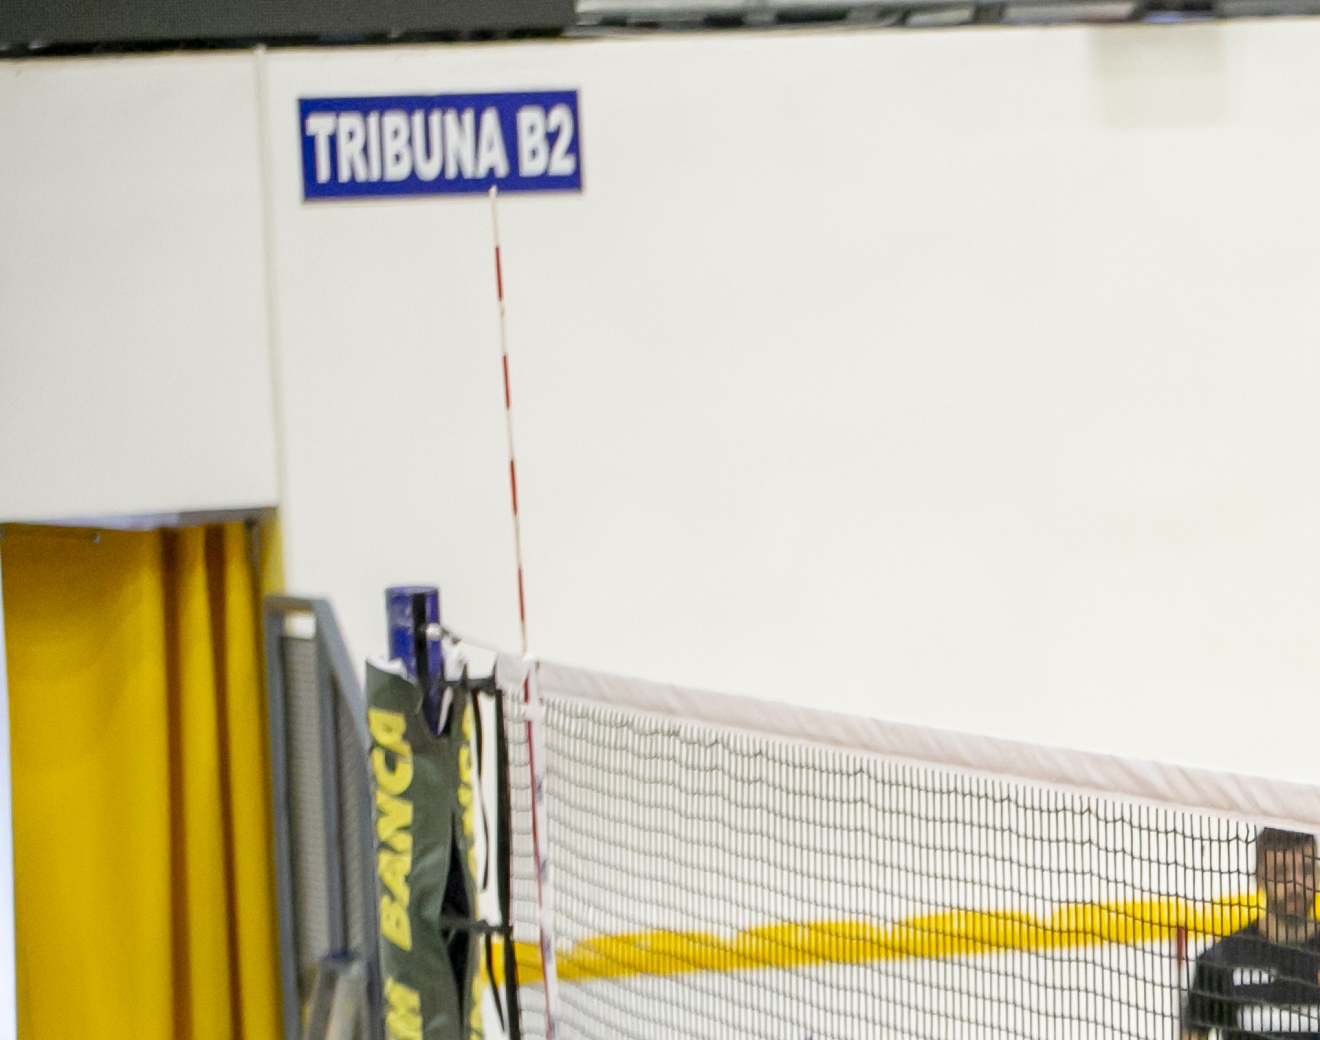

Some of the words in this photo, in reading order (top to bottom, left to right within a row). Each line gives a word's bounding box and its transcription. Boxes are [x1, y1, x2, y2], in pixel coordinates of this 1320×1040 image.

[305, 106, 510, 184] TRIBUNA
[516, 103, 577, 177] B2
[367, 708, 415, 951] BANCA
